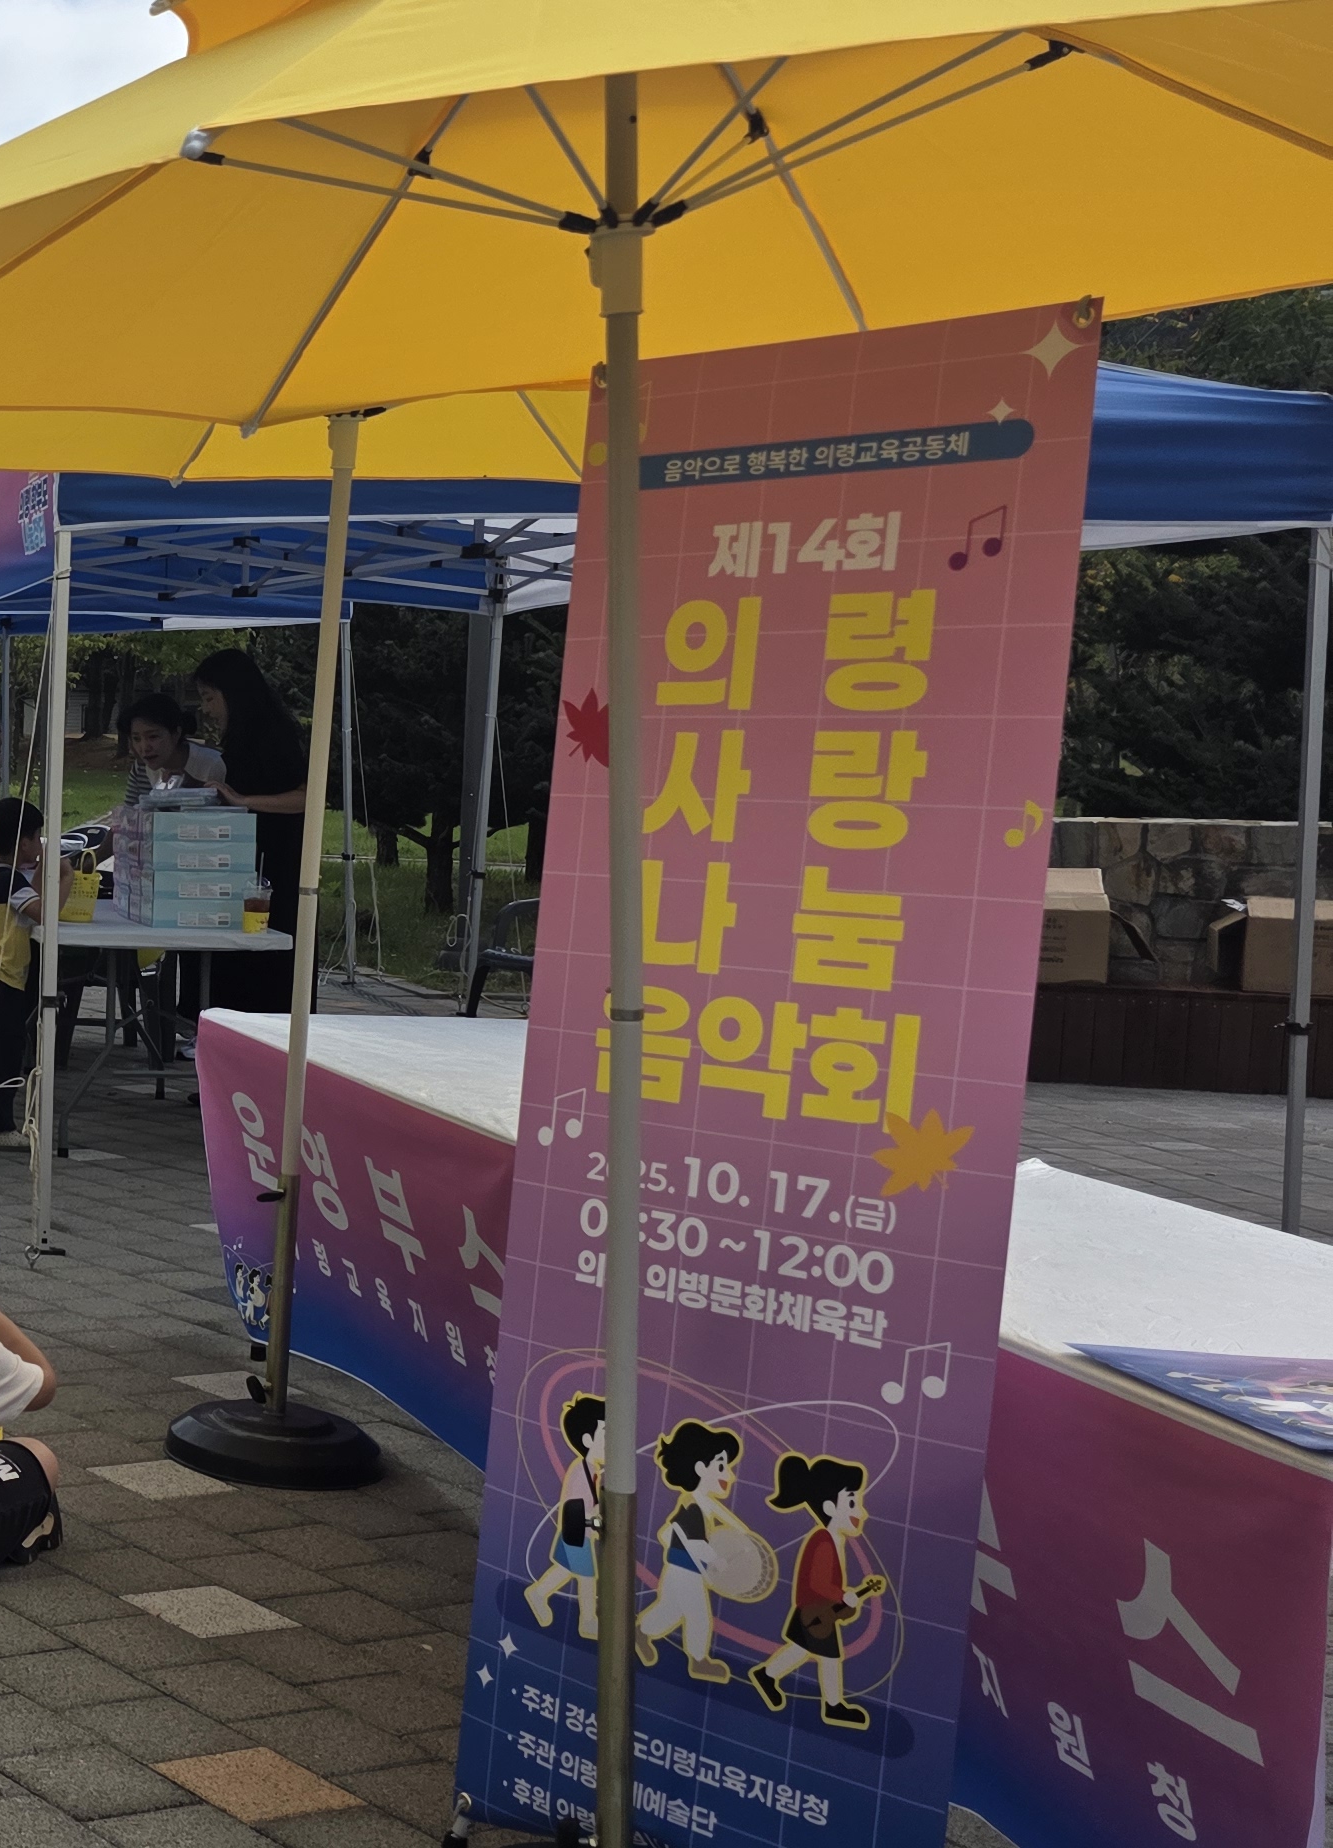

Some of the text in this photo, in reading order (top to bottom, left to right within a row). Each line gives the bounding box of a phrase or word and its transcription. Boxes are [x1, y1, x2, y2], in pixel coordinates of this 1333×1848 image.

[664, 431, 971, 483] 음악으로 행복한 의령교육공동체
[707, 511, 902, 578] 제14회
[642, 729, 927, 850] 사랑
[641, 859, 904, 991] 나눔
[595, 986, 921, 1134] 음악회
[232, 1092, 505, 1319] 운영부스
[295, 1238, 497, 1387] 령교육지원청
[644, 1264, 888, 1349] 의병문화체육관
[521, 1684, 560, 1724] 주최
[517, 1730, 556, 1771] 주관
[512, 1777, 551, 1816] 후원
